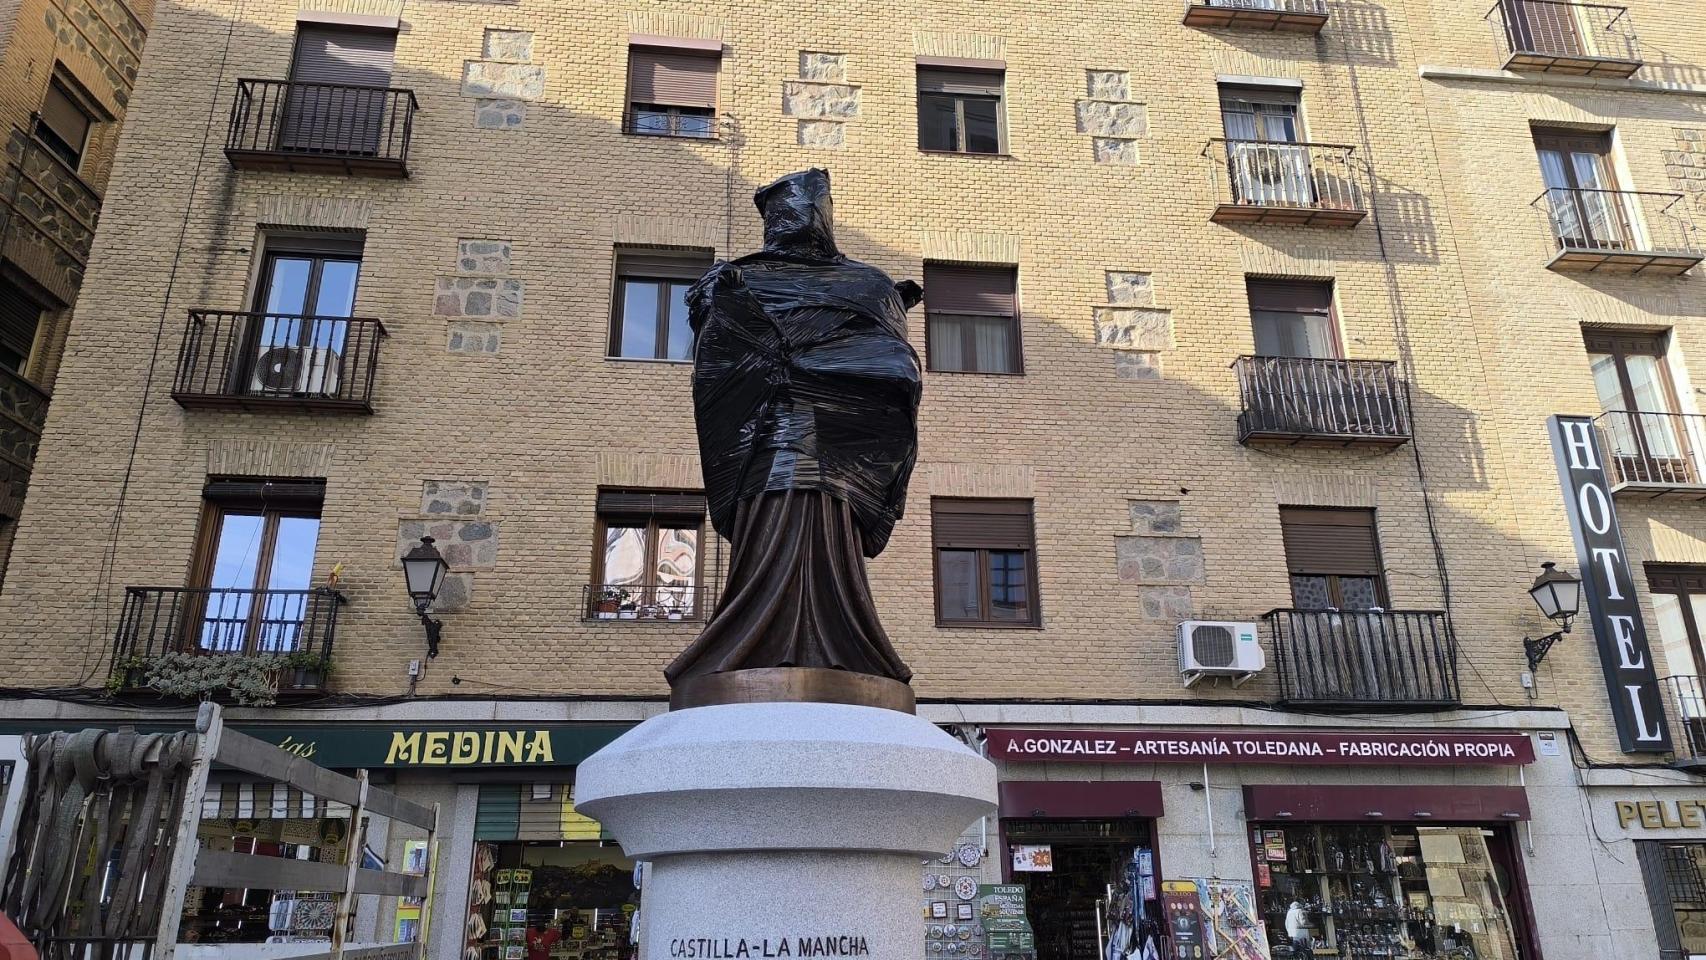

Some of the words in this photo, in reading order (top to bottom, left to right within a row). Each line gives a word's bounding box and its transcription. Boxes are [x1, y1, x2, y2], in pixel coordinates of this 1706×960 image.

[1560, 421, 1663, 742] HOTEL
[385, 731, 554, 764] MEDINA
[1007, 738, 1117, 754] A.GONZALEZ
[1134, 737, 1231, 755] ARTESANÍA
[1233, 741, 1324, 756] TOLEDANA
[1339, 740, 1450, 757] FABRICACIÓN
[1454, 743, 1515, 757] PROPIA
[993, 886, 1024, 894] TOLEDO
[994, 894, 1024, 902] ESPAÑA
[670, 938, 791, 959] CASTILLA-LA
[798, 935, 869, 957] MANCHA
